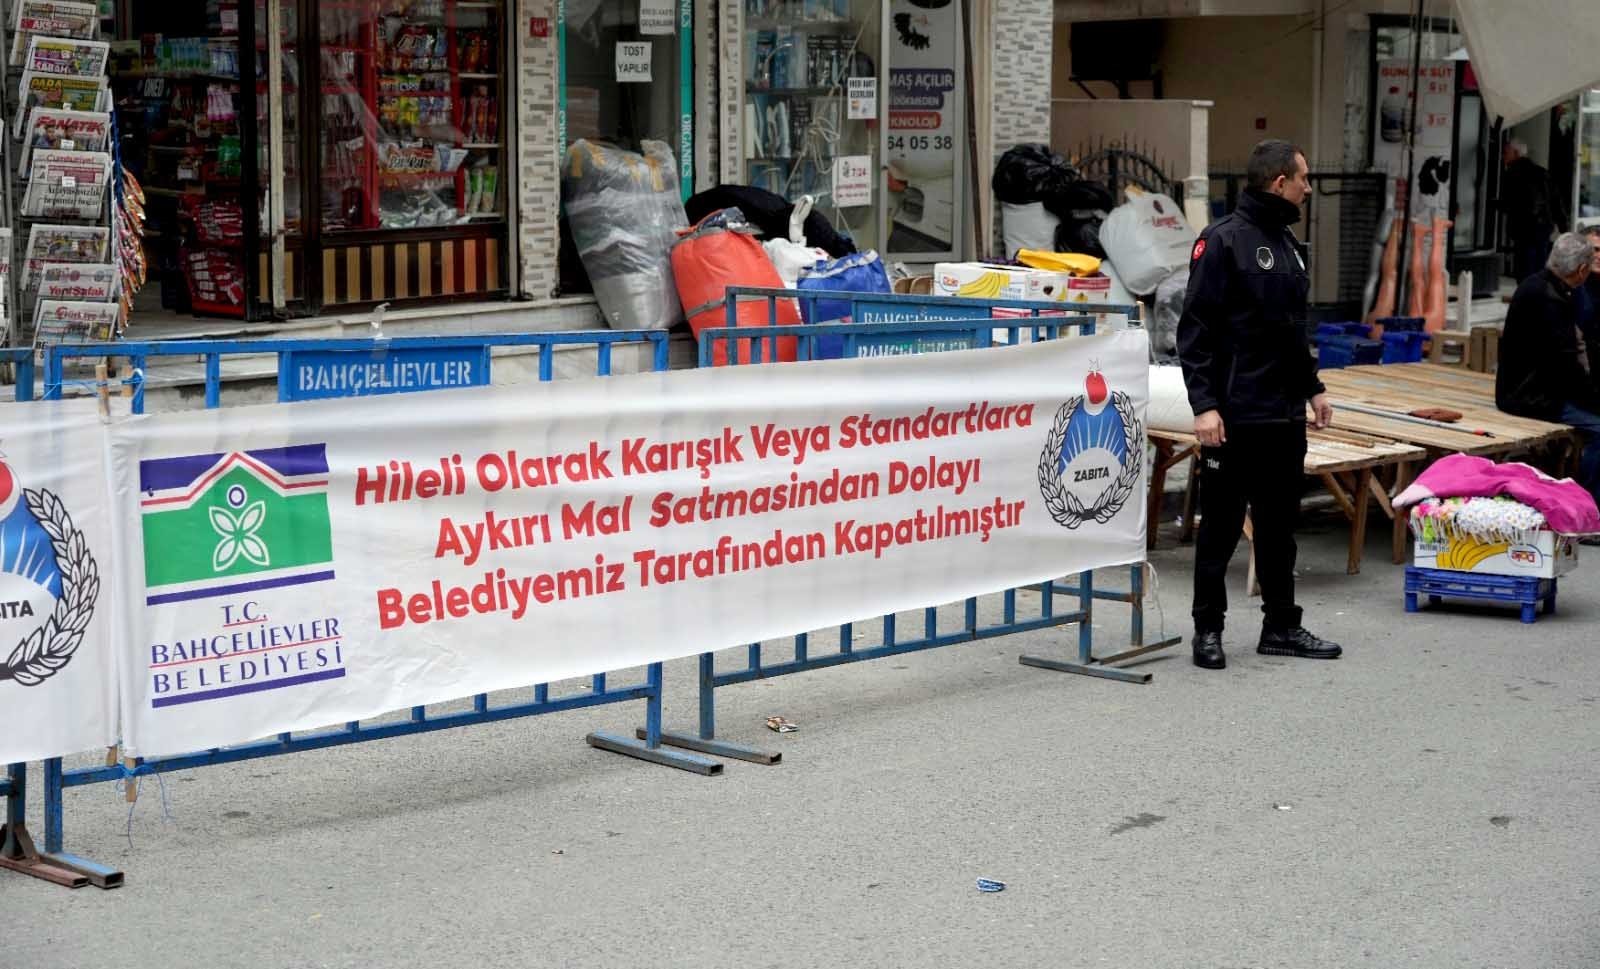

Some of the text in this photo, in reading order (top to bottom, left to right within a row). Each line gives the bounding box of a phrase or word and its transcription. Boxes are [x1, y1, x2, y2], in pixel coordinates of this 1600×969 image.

[618, 63, 649, 73] YAPILIR
[624, 46, 645, 57] TOST
[914, 73, 953, 91] AÇILIR
[681, 114, 692, 177] ORGANICS
[910, 135, 928, 150] 05
[934, 135, 953, 150] 38
[299, 357, 472, 396] BAHÇELİEVLER
[356, 402, 1035, 505] Hileli Olarak Karışık Veya Standartlara
[1074, 466, 1110, 483] ZABITA
[435, 456, 980, 567] Aykırı Mal Satmasindan Dolayı
[377, 497, 1025, 629] Belediyemiz Tarafından Kapatılmıştır
[221, 601, 268, 625] T.C.
[151, 617, 340, 659] BAHÇELİEVLER
[153, 641, 342, 694] BELEDİYESİ
